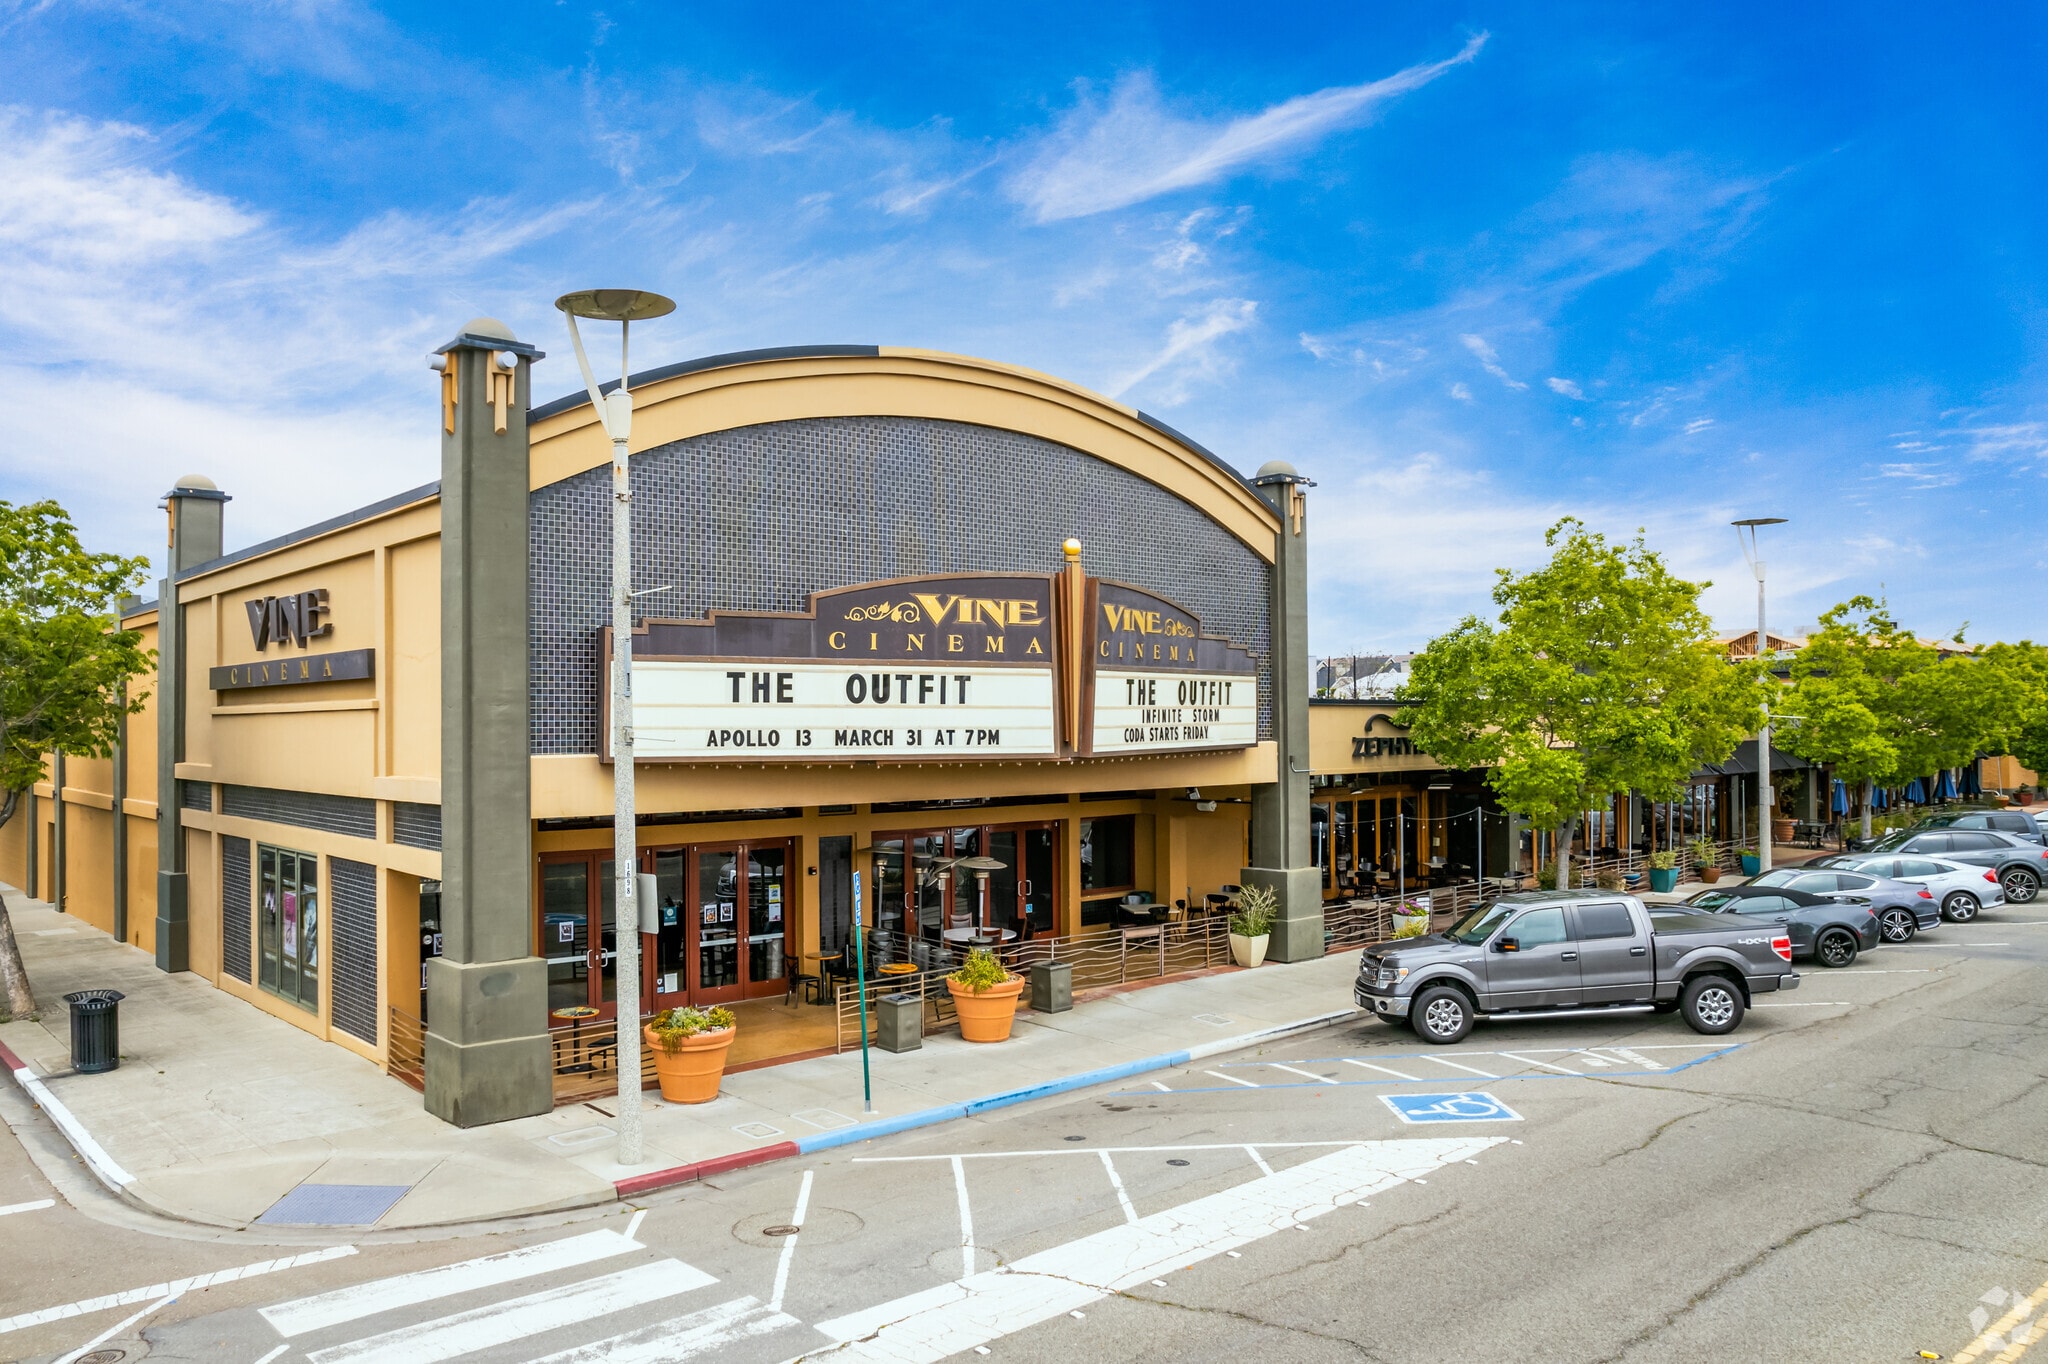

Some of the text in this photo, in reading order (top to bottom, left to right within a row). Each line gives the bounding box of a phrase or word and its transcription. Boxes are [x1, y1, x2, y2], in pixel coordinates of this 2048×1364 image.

[245, 589, 334, 651] VINE
[909, 592, 1045, 630] VINE
[1103, 604, 1163, 636] VINE
[828, 631, 1044, 654] CINEMA
[1101, 641, 1195, 661] CINEMA
[231, 659, 332, 685] CINEMA
[726, 671, 972, 705] THE OUTFIT
[1127, 679, 1232, 705] THE OUTFIT
[1141, 709, 1220, 724] INFINITE STORM
[706, 729, 781, 748] APOLLO
[795, 729, 813, 747] 13
[834, 729, 894, 747] MARCH
[906, 729, 923, 747] 31
[934, 729, 956, 746] AT
[1124, 726, 1209, 742] CODA STARTS FRIDAY
